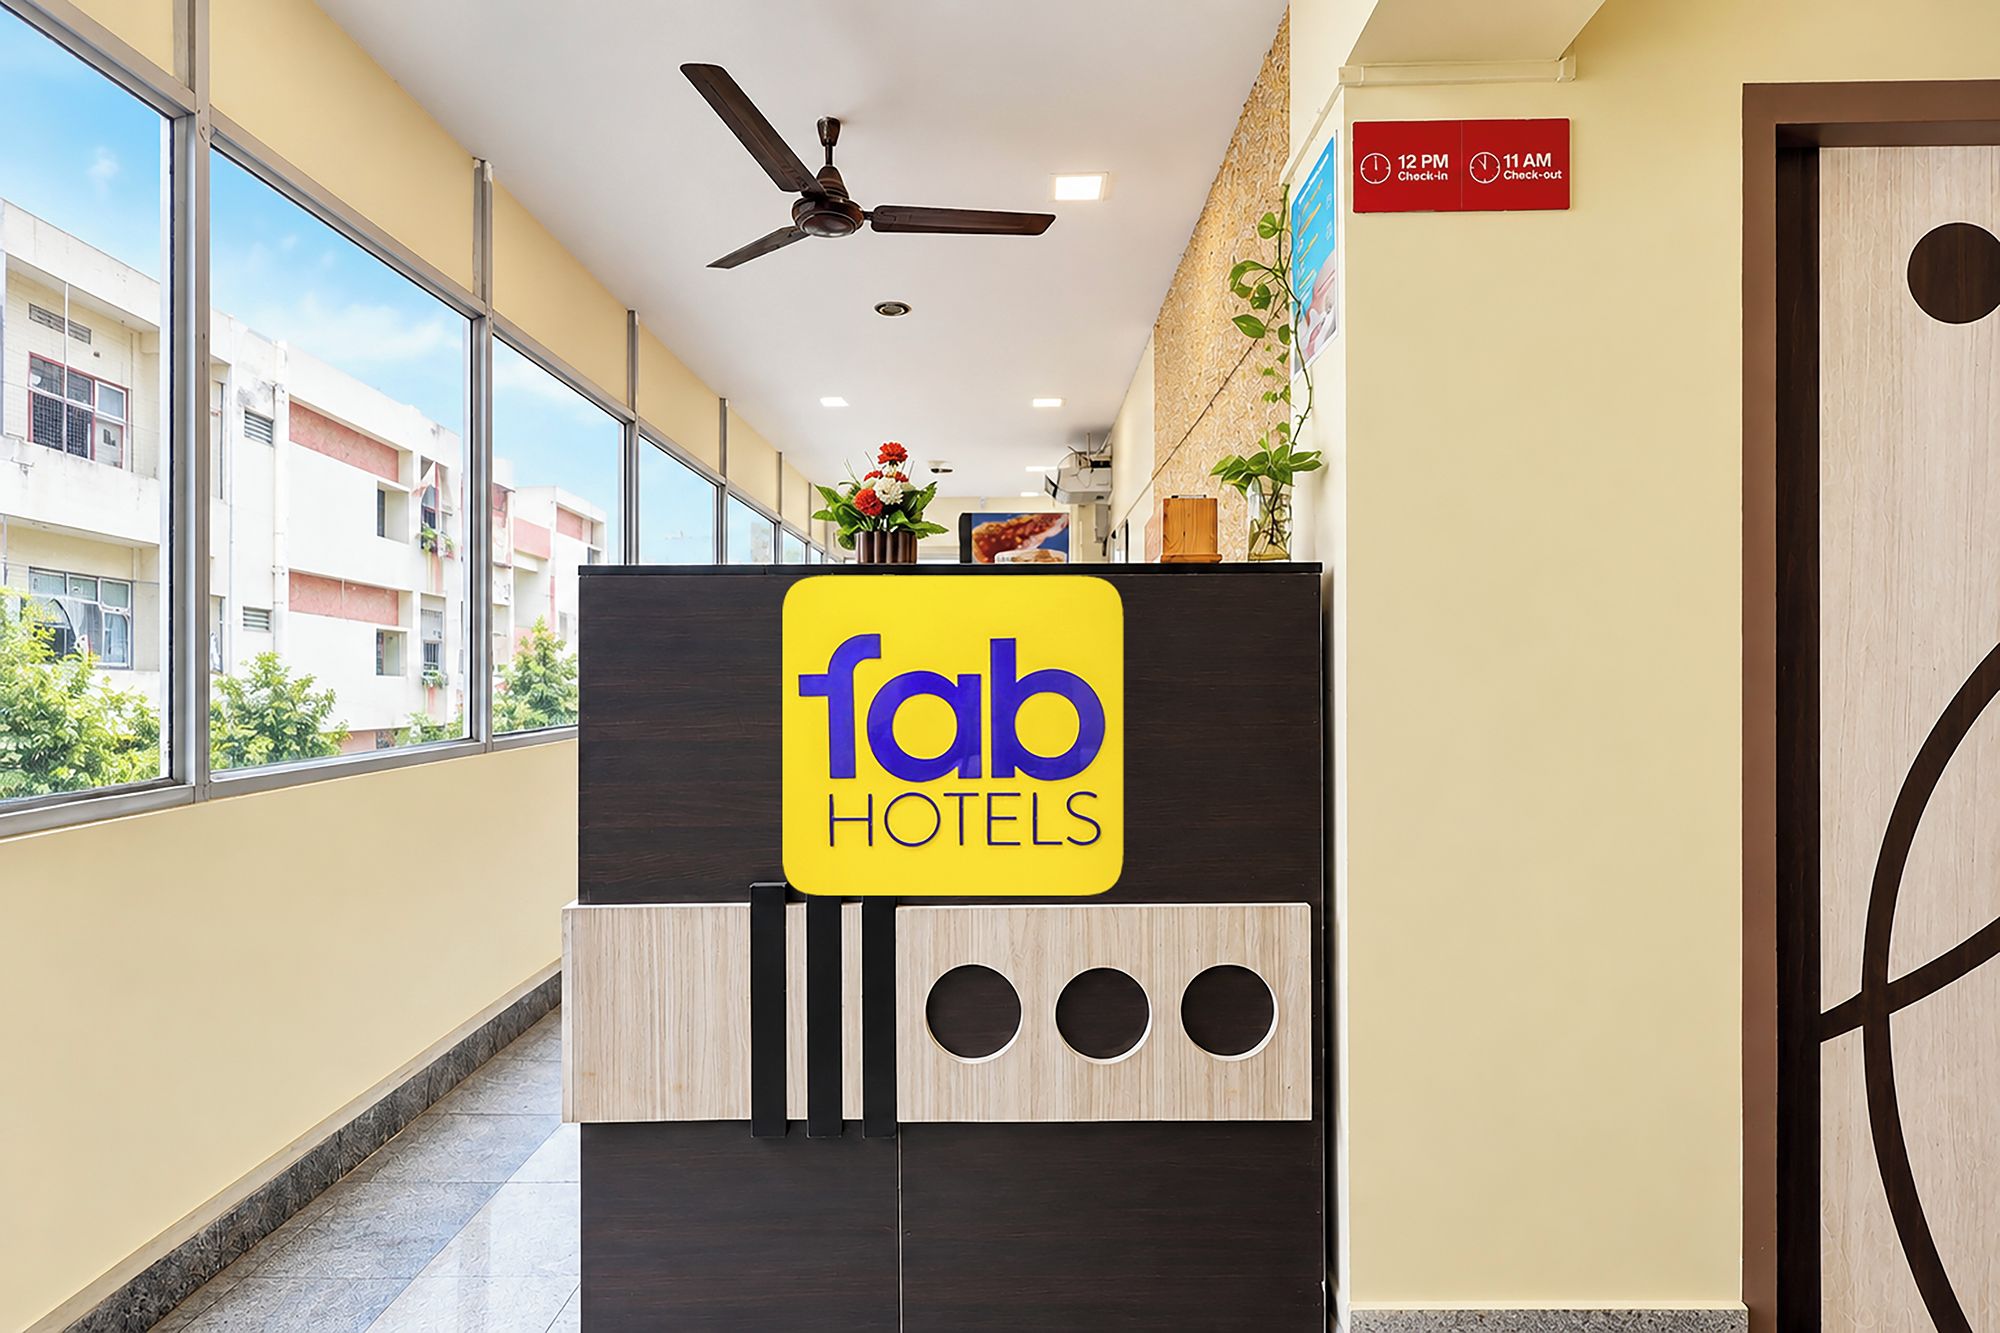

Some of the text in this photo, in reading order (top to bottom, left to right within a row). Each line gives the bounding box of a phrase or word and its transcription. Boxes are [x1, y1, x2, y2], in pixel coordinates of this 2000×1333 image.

[1398, 154, 1449, 169] 12 PM
[1503, 153, 1551, 168] 11 AM
[1397, 170, 1448, 181] Check-in
[1503, 169, 1562, 180] Check-out
[798, 633, 1106, 783] fab
[829, 791, 1101, 847] HOTELS
